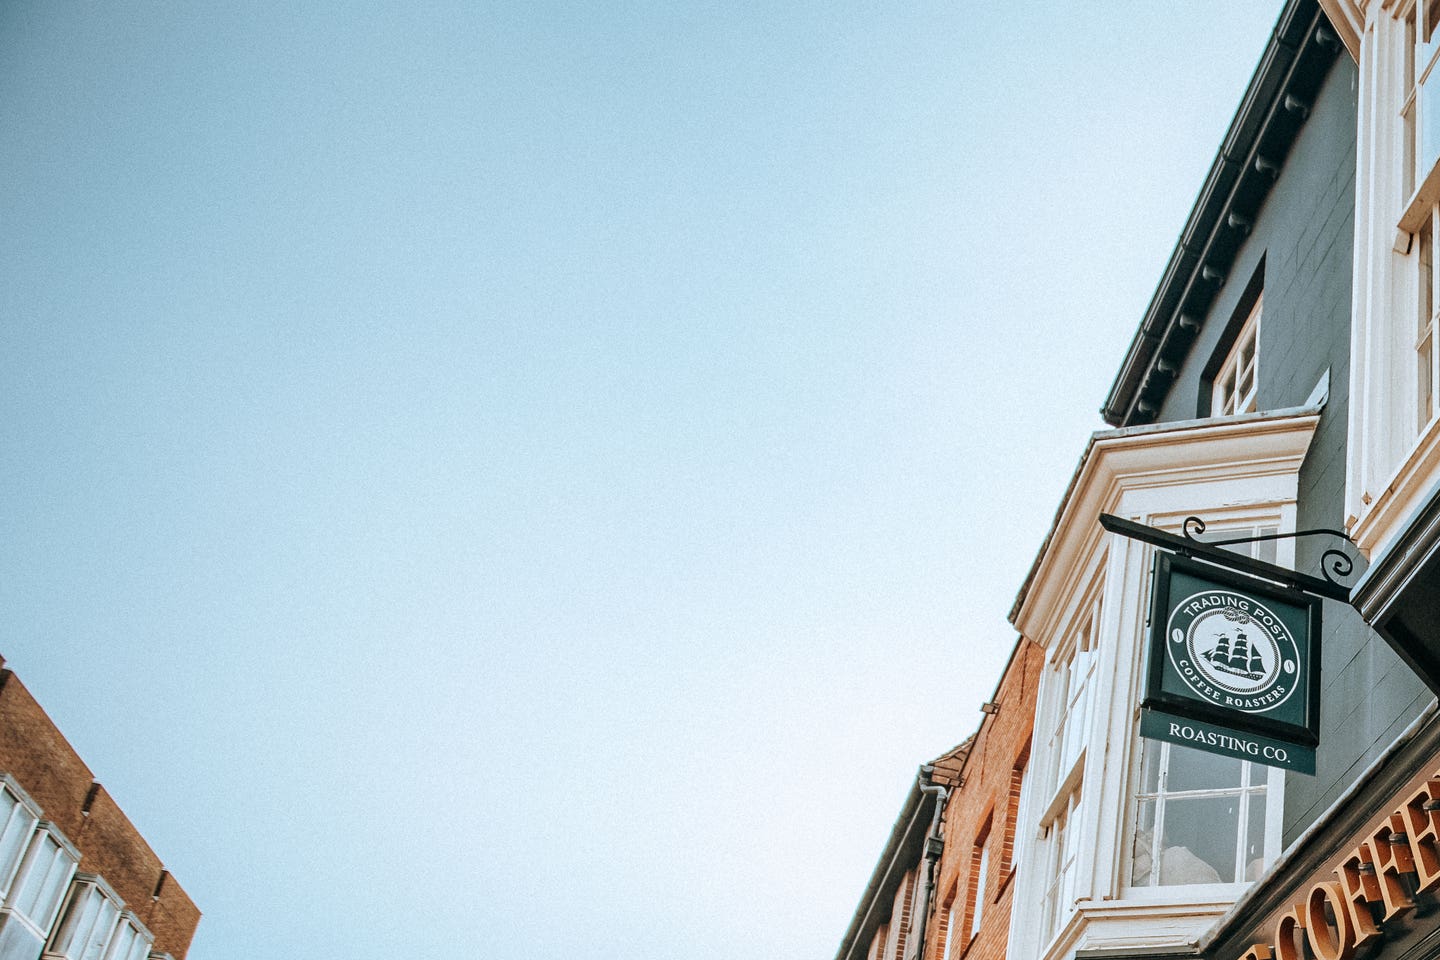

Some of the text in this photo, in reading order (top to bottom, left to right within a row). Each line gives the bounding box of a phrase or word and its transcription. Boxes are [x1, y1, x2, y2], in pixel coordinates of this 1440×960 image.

[1183, 595, 1289, 643] TRADING POST
[1179, 659, 1285, 708] COFFEE ROASTERS
[1169, 722, 1291, 763] ROASTING CO.
